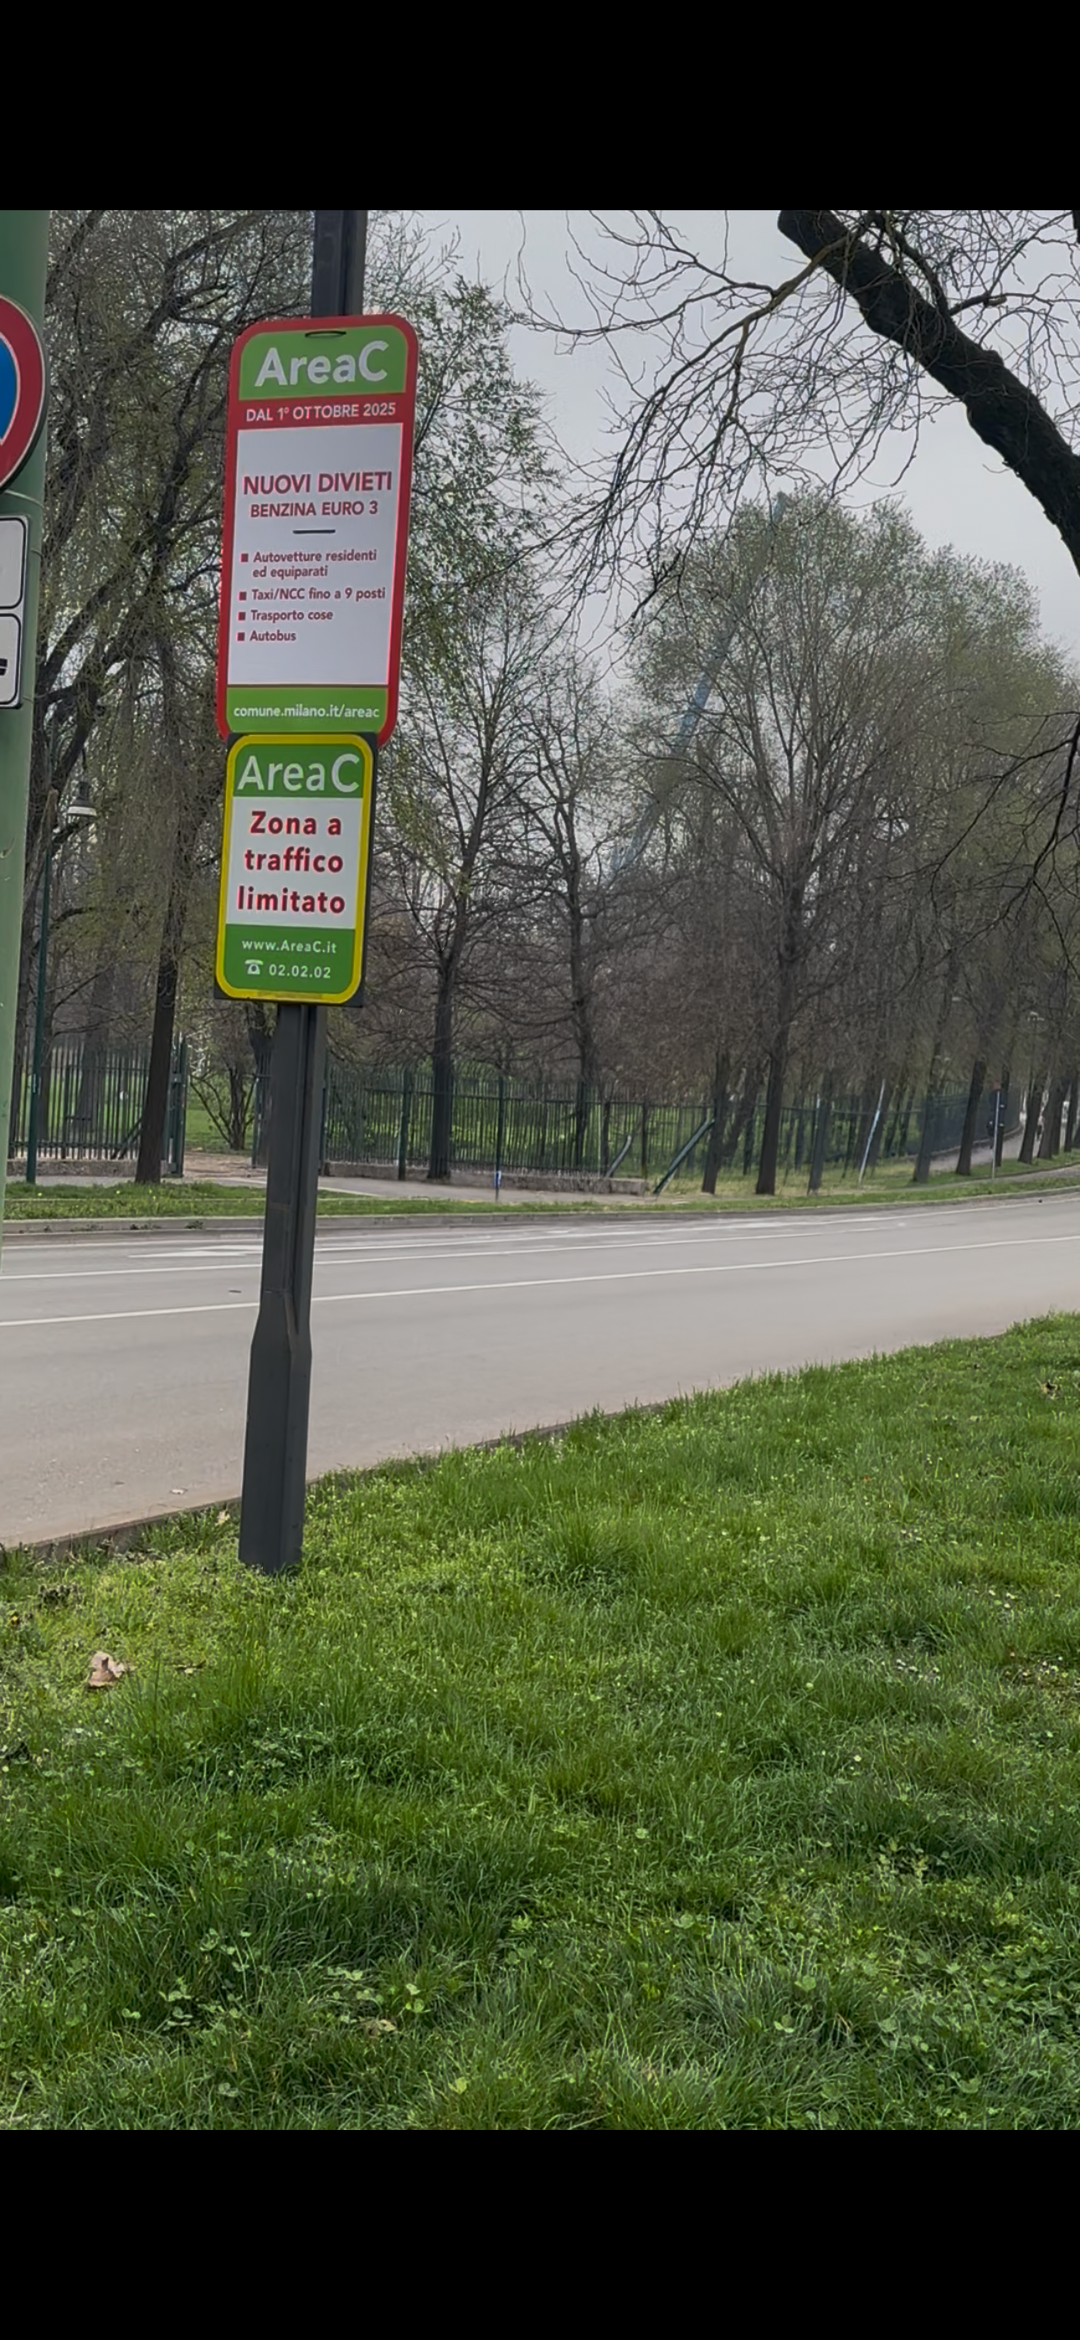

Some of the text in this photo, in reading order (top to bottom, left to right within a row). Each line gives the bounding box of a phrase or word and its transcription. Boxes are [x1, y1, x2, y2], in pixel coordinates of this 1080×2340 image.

[254, 340, 389, 387] AreaC
[246, 408, 273, 422] DAL
[293, 404, 359, 420] OTTOBRE
[363, 402, 396, 416] 2025
[243, 471, 392, 495] NUOVI DIVIETI
[251, 501, 378, 517] BENZINA EURO 3
[253, 550, 377, 563] Autovetture residenti
[252, 565, 328, 580] ed equiparati
[252, 587, 385, 601] Taxi/NCC fino a 9 posti
[251, 610, 333, 623] Trasporto cose
[250, 630, 296, 641] Autobus
[233, 704, 379, 718] comune.milano.it/areac
[250, 811, 342, 835] Zona a
[245, 847, 343, 873] traffico
[237, 885, 345, 914] limitato
[242, 940, 337, 953] www.AreaC.it
[269, 964, 331, 978] 02.02.02
